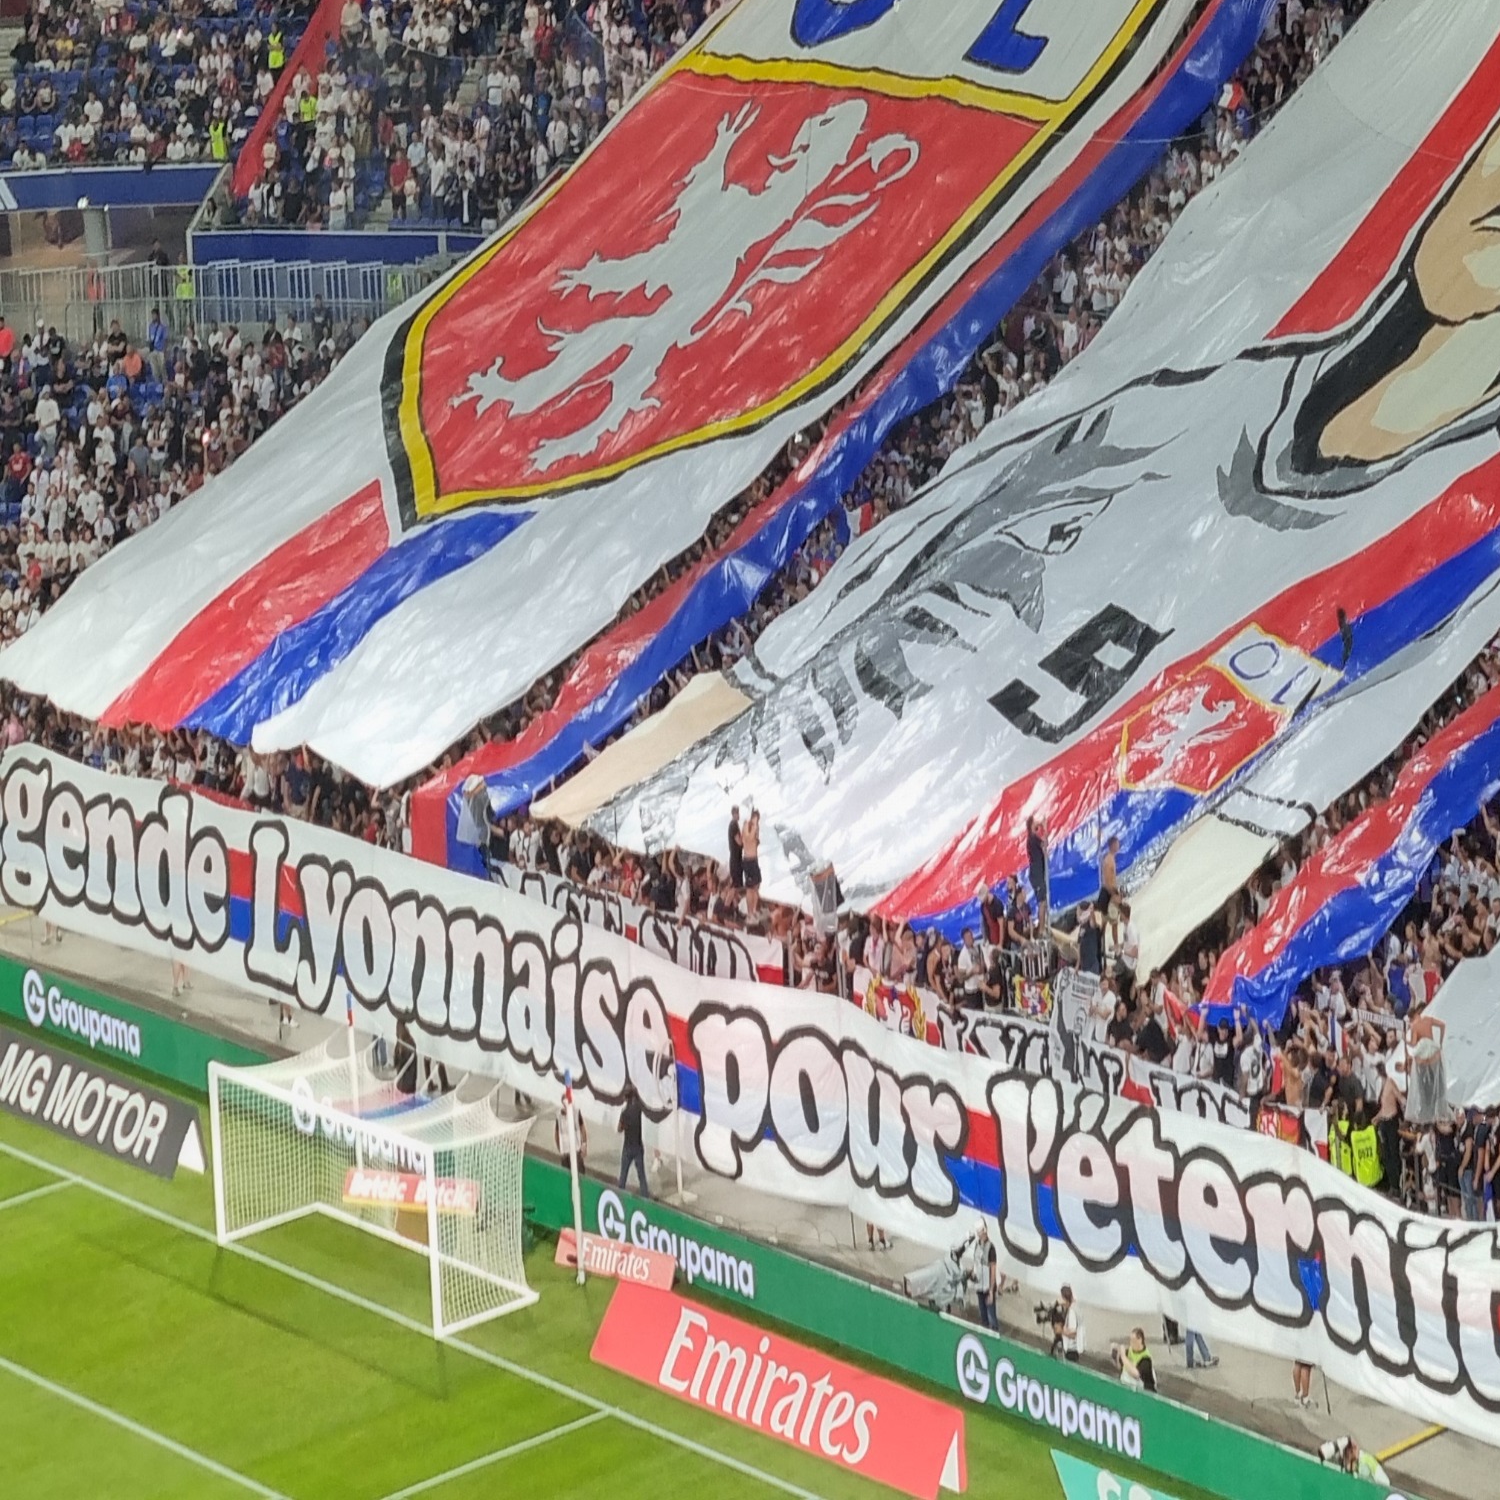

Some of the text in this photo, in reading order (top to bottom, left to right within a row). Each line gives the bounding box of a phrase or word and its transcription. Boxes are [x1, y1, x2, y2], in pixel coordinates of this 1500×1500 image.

[48, 986, 141, 1058] Groupama
[244, 819, 678, 1124] Lyonnaise
[694, 1000, 968, 1217] pour
[0, 1042, 169, 1165] MG MOTOR
[580, 1238, 651, 1282] Emirates
[630, 1210, 755, 1299] Groupama
[657, 1305, 878, 1465] Emirates
[995, 1356, 1142, 1460] Groupama
